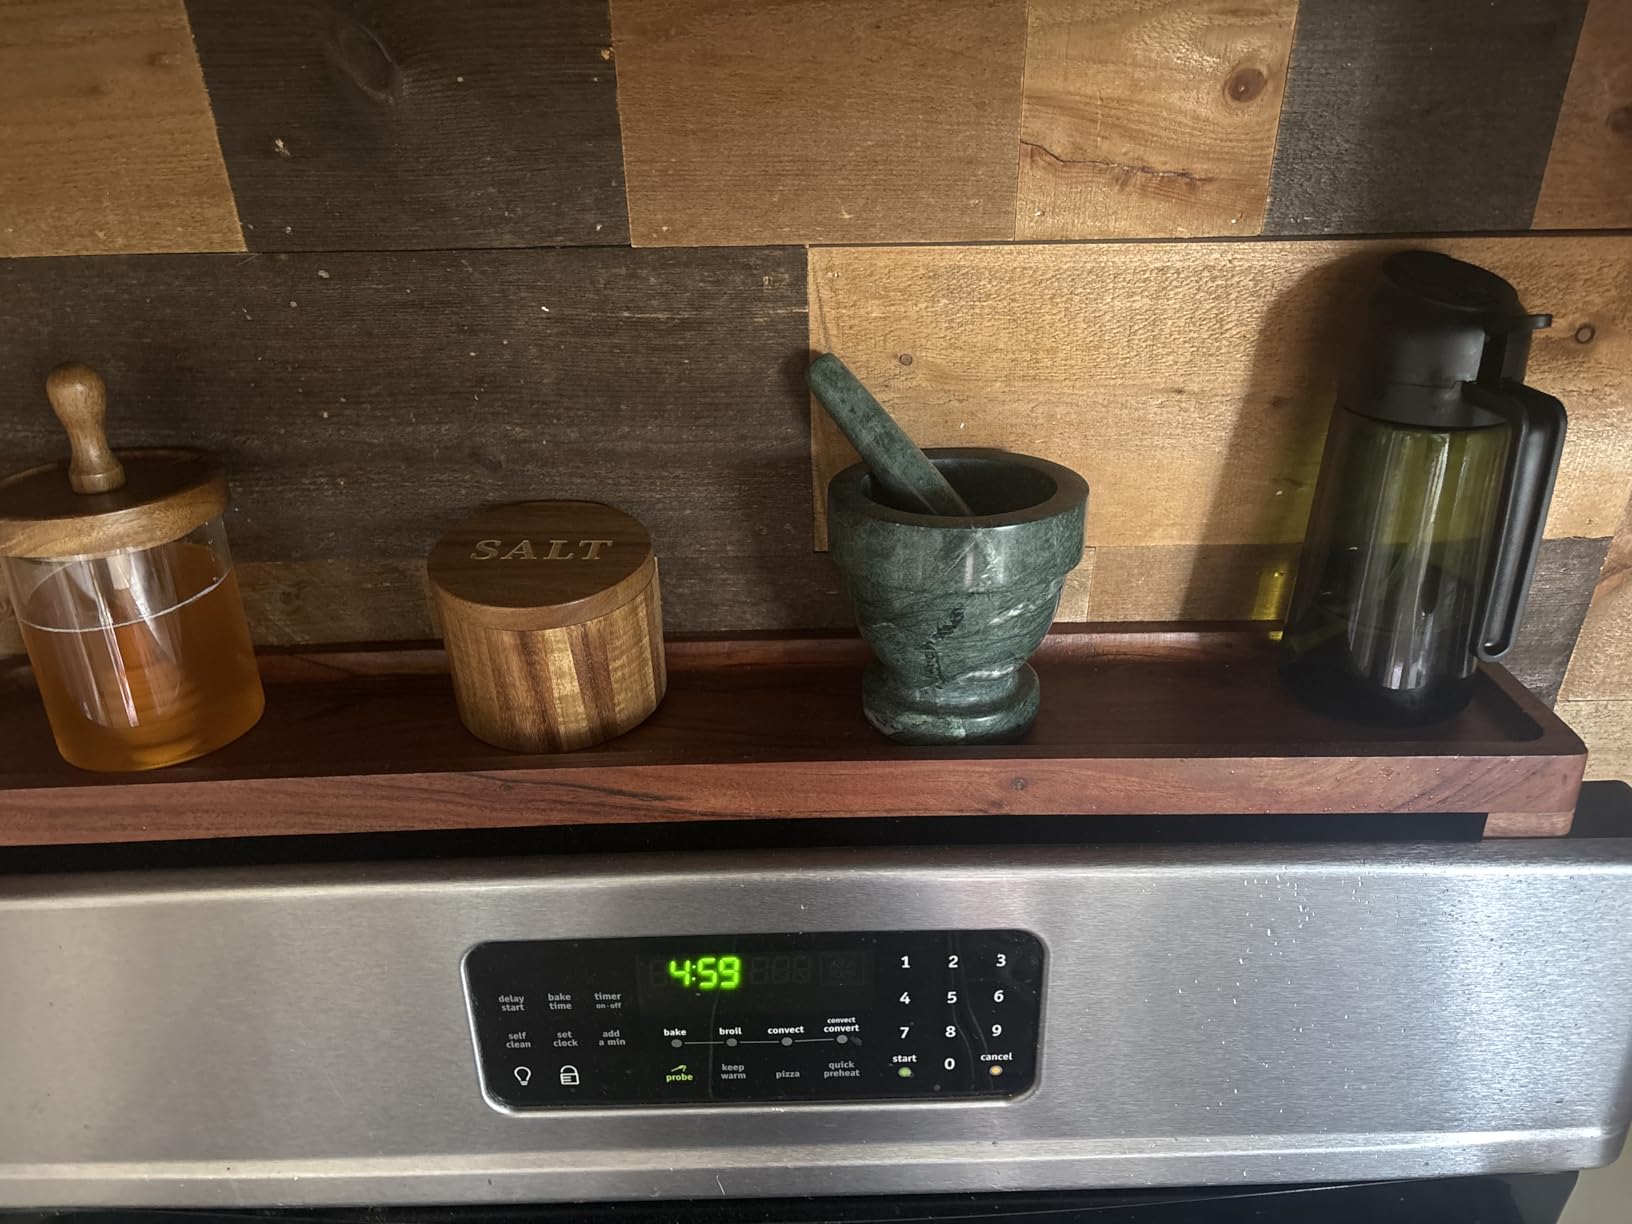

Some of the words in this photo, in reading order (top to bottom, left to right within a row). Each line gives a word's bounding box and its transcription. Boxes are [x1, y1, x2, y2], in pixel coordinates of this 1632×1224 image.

[470, 540, 613, 560] SALT
[901, 956, 911, 968] 1
[948, 955, 959, 968] 2
[996, 954, 1006, 967] 3
[670, 957, 741, 989] 4:59
[499, 995, 524, 1005] delay
[548, 993, 571, 1001] bake
[595, 992, 621, 1000] timer
[900, 992, 911, 1004] 4
[947, 991, 957, 1003] 5
[994, 990, 1004, 1002] 6
[549, 1002, 572, 1010] time
[663, 1028, 687, 1036] bake
[719, 1027, 742, 1035] broil
[768, 1026, 804, 1034] convect
[900, 1027, 909, 1039] 7
[945, 1026, 956, 1037] 8
[992, 1025, 1002, 1036] 9
[553, 1039, 578, 1047] clock
[980, 1052, 1013, 1061] cancel
[722, 1064, 744, 1073] keep
[829, 1061, 855, 1070] quick
[944, 1058, 955, 1070] 0
[666, 1073, 693, 1082] probe
[776, 1070, 800, 1079] pizza
[824, 1069, 859, 1079] preheat
